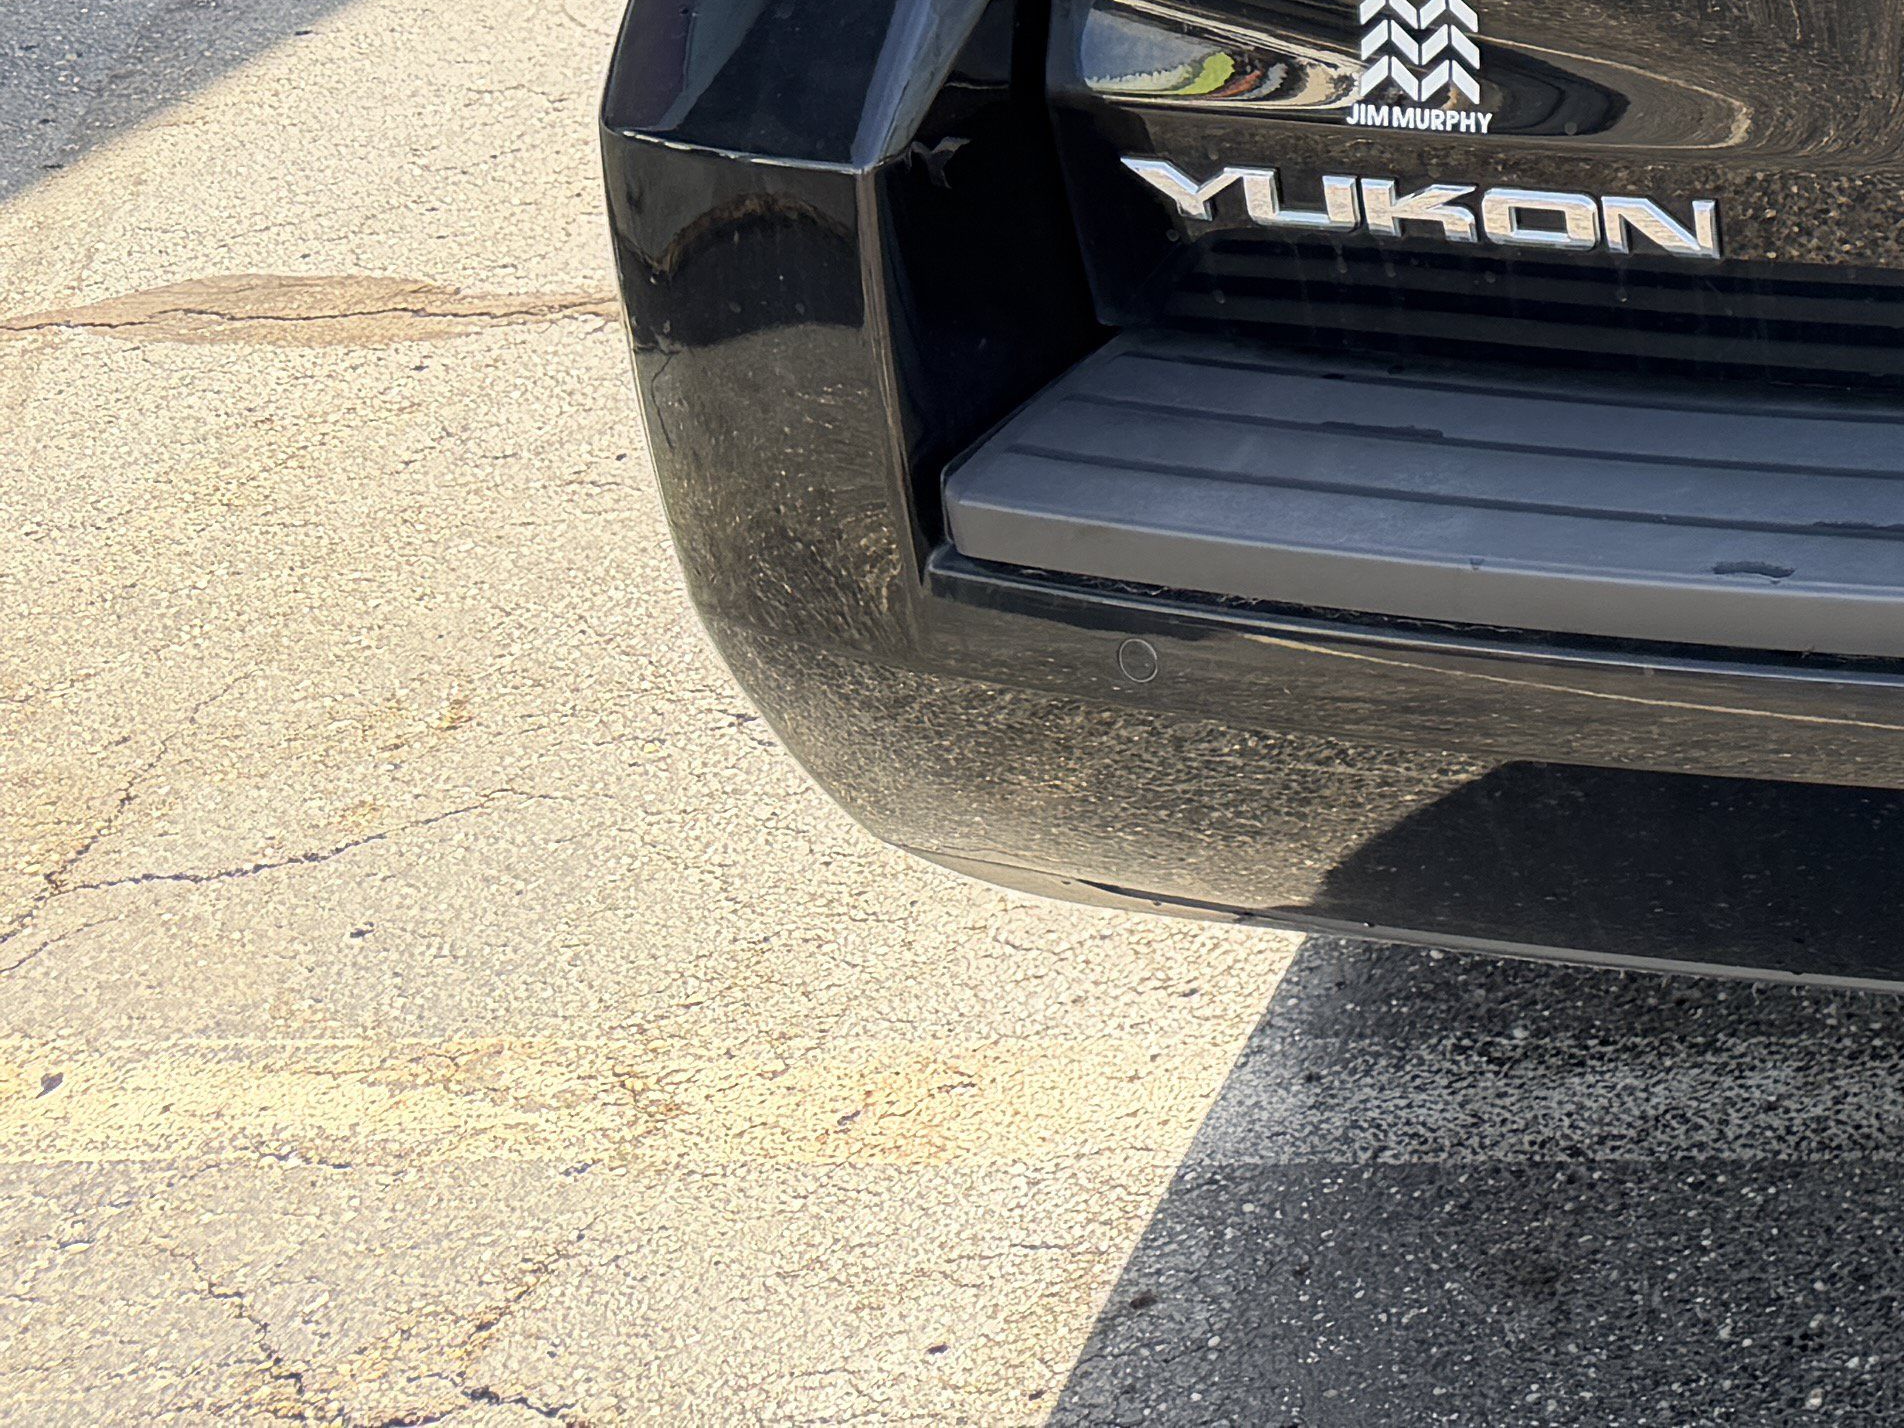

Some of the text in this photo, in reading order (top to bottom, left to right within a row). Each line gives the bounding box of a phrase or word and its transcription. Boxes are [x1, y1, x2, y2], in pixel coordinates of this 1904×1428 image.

[1346, 102, 1493, 134] JIM MURPHY
[1120, 156, 1722, 260] YUKON
